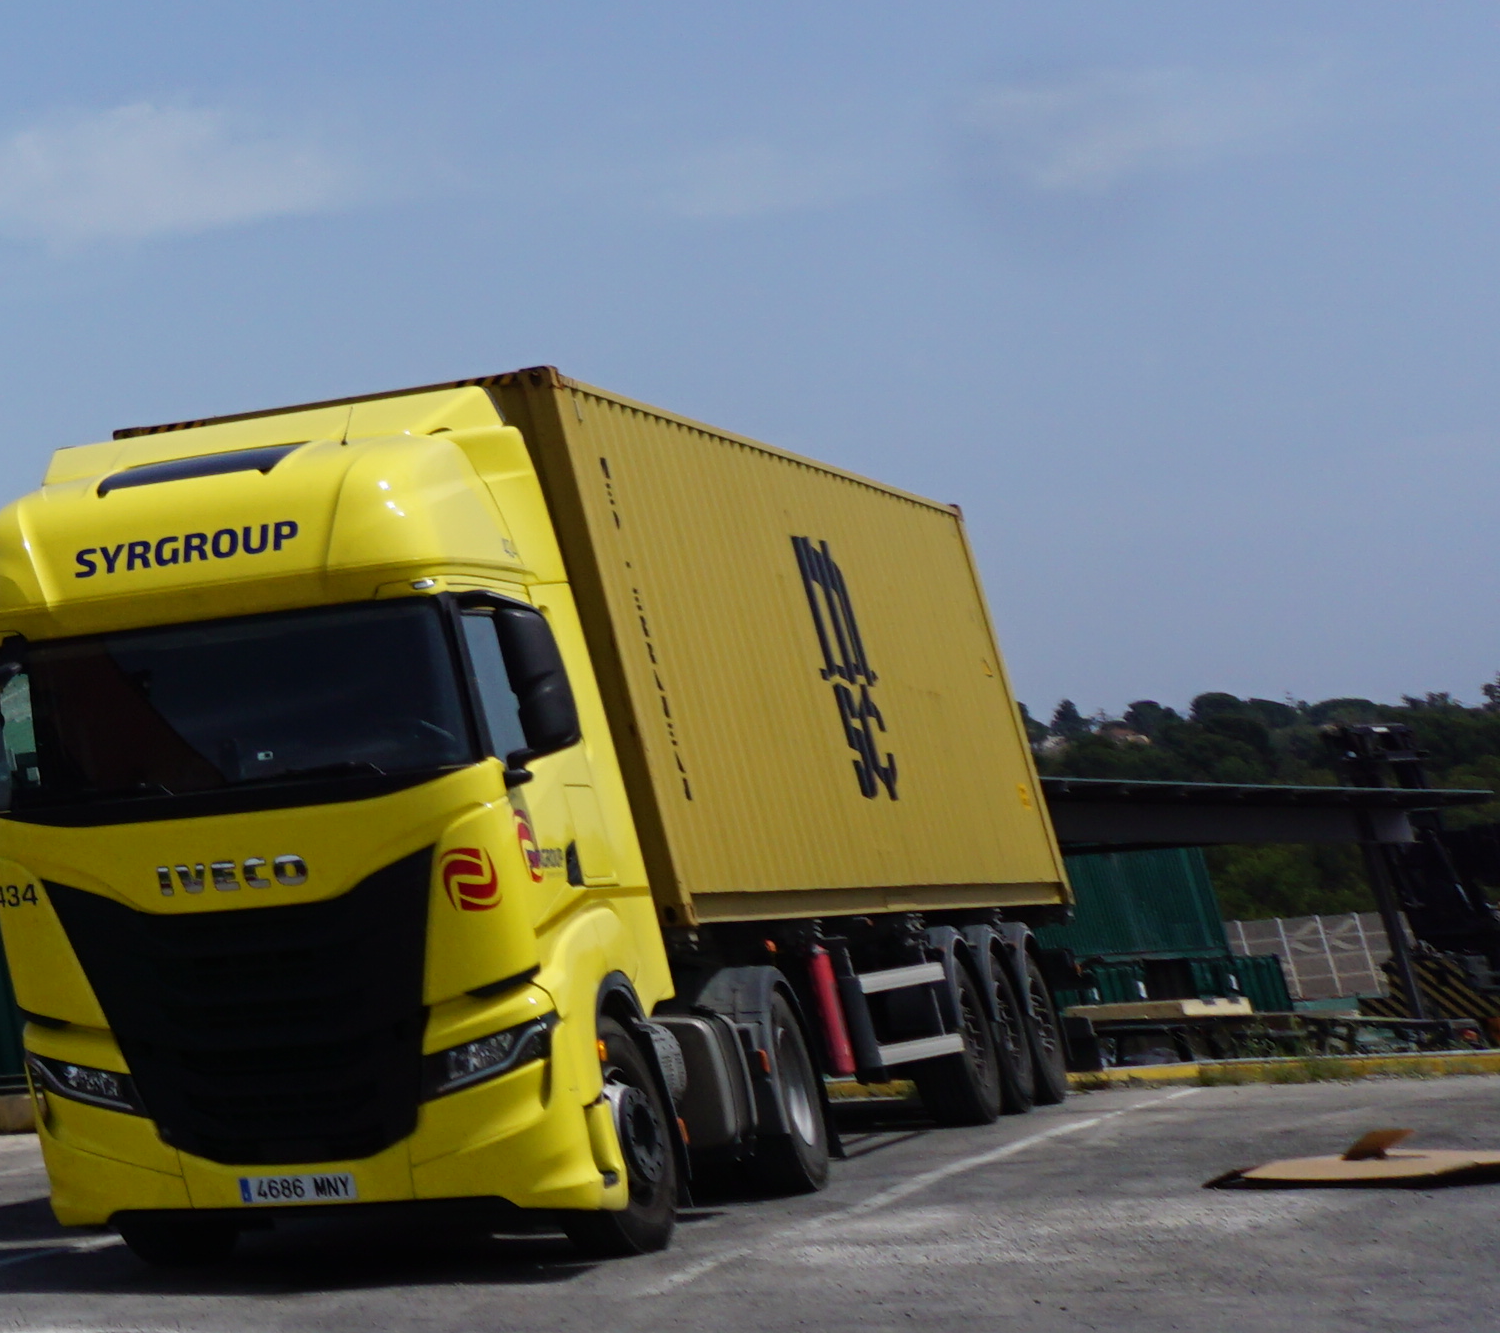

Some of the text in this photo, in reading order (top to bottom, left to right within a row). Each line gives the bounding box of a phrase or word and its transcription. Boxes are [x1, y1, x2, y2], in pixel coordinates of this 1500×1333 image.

[74, 520, 299, 579] SYRGROUP
[156, 854, 309, 896] IVECO
[257, 1176, 350, 1200] 4686 MNY
